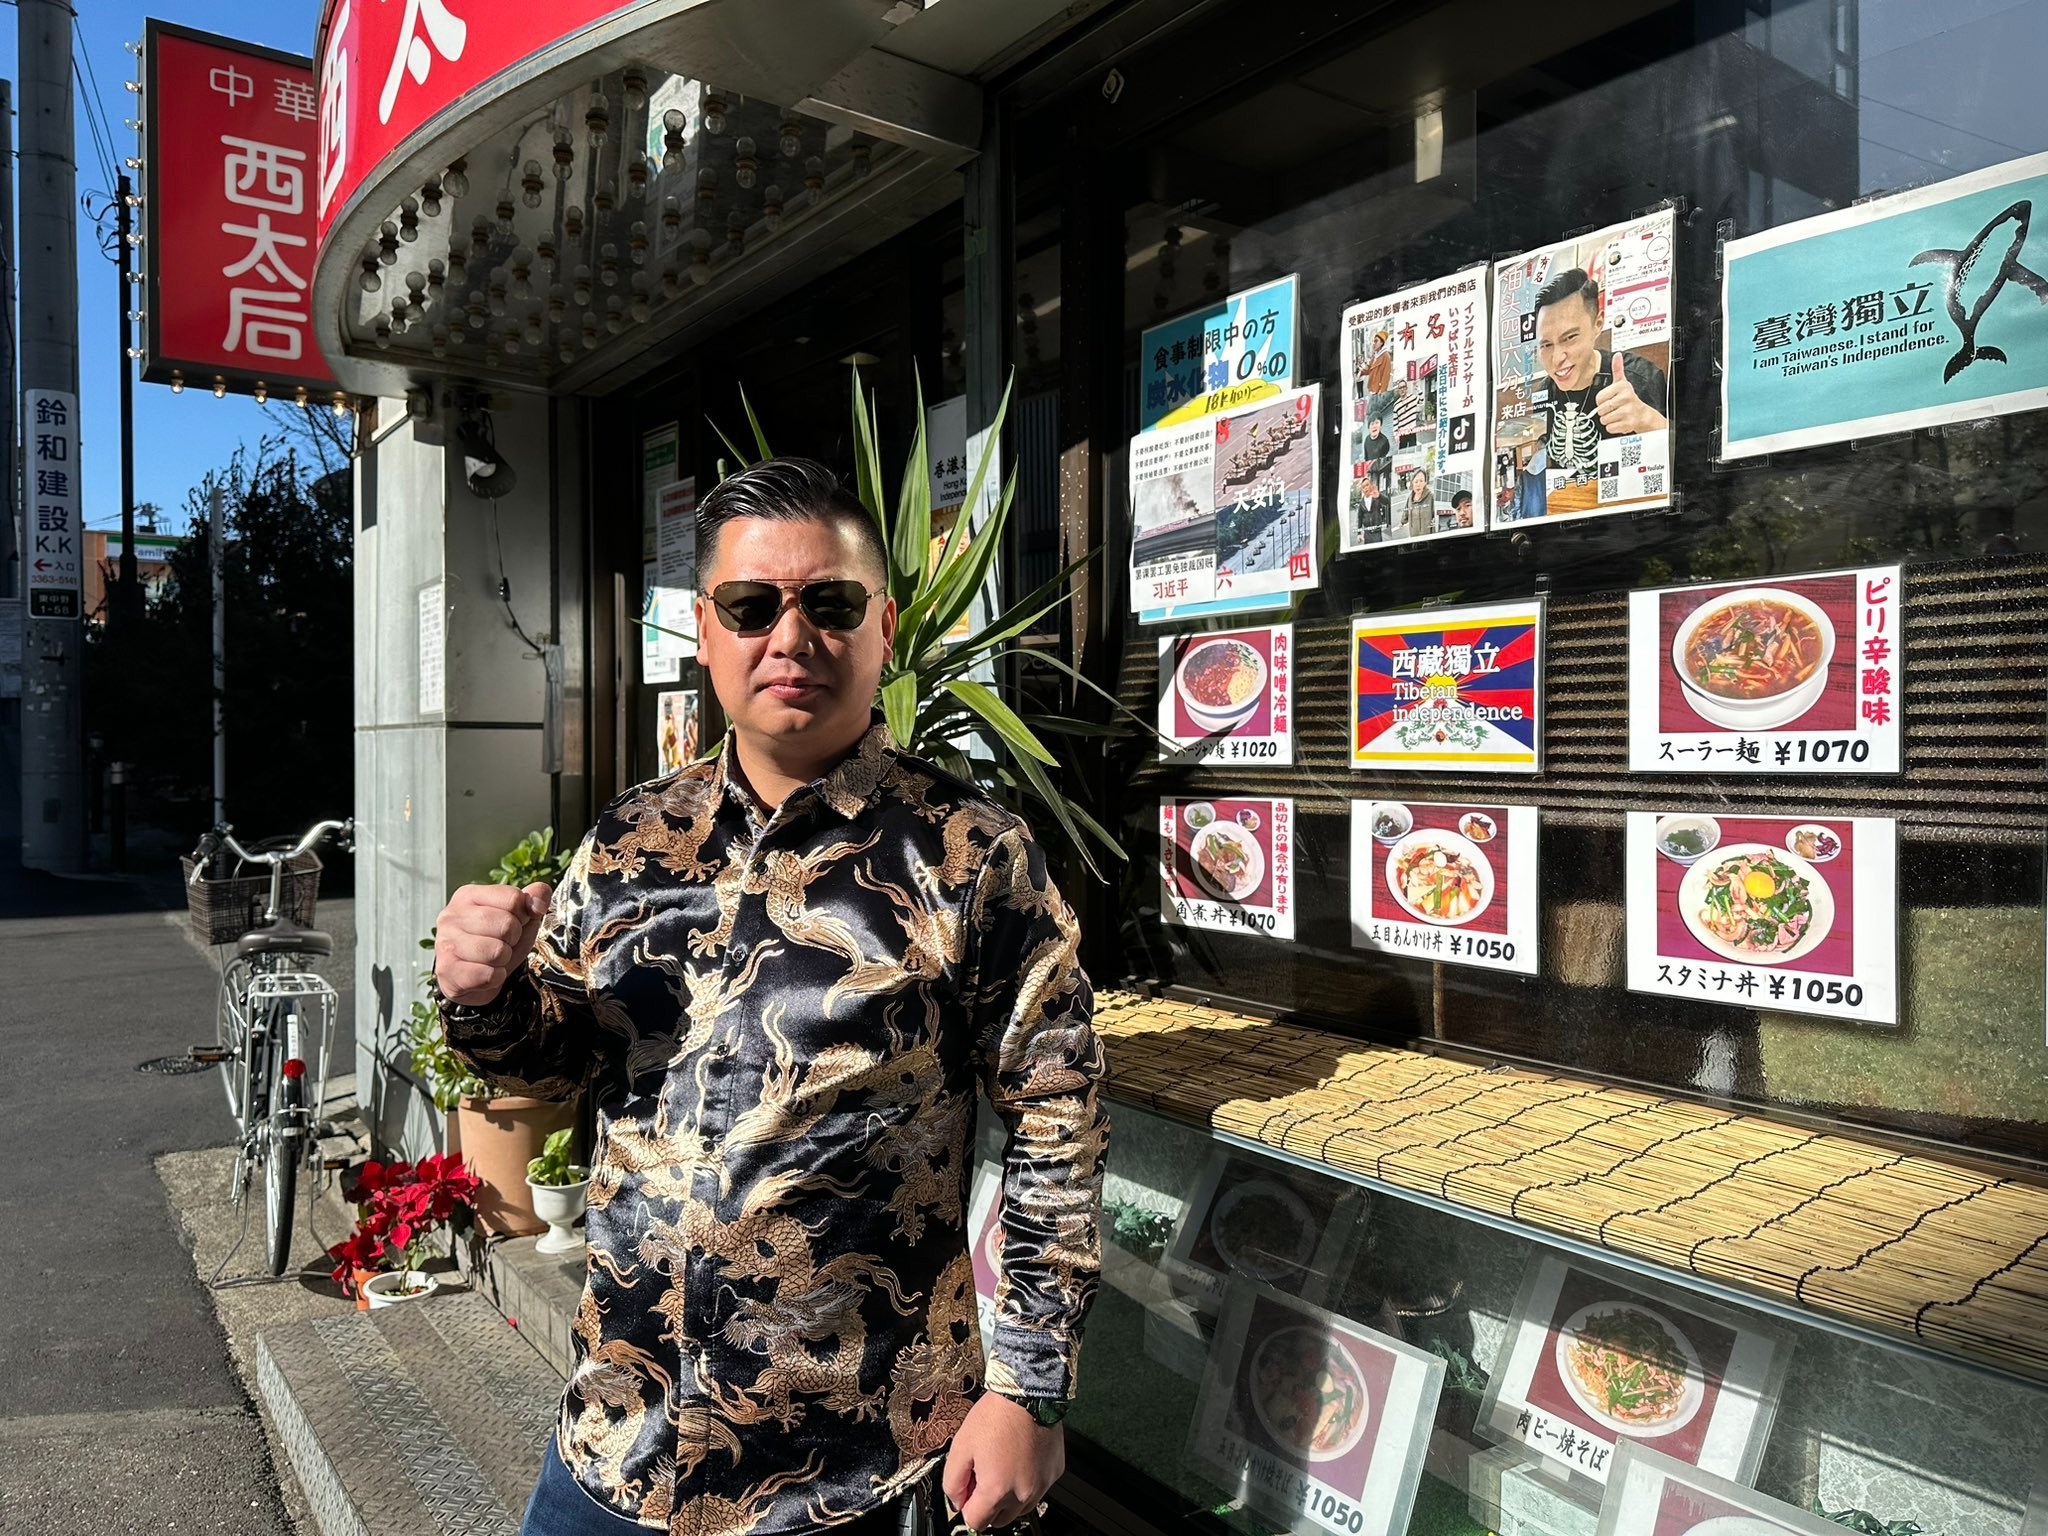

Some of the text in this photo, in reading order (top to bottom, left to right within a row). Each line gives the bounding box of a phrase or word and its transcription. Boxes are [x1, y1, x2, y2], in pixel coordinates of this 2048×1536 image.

[210, 65, 316, 122] 中華
[221, 134, 307, 361] 西太后
[1534, 256, 1550, 284] 有名
[1348, 279, 1476, 327] 受歡迎的影響者來到我們的商店
[1752, 282, 1934, 353] 臺灣獨立
[1153, 308, 1280, 372] 食事制限中の方
[1397, 313, 1445, 351] 有名
[1753, 320, 1935, 370] I am Taiwanese. I stand for
[1463, 302, 1475, 408] インフルエンサーが
[1782, 334, 1949, 377] Taiwan's Independence.
[1294, 394, 1312, 422] 9
[1501, 402, 1526, 420] 来店
[1216, 417, 1230, 445] 8
[36, 398, 69, 533] 鈴和建設
[1233, 478, 1286, 513] 天安门
[55, 562, 75, 572] 入口
[1216, 566, 1233, 590] 六
[1289, 553, 1310, 580] 四
[1152, 578, 1188, 599] 习近平
[1391, 642, 1500, 679] 西藏獨立
[1862, 576, 1891, 725] ピリ辛酸味
[1391, 682, 1458, 701] Tibetan
[1391, 703, 1523, 722] independence
[1231, 741, 1277, 758] ¥1020
[1658, 736, 1869, 765] スーラー麺 ¥1070
[1275, 803, 1288, 914] 品切れの場合が有ります
[1175, 901, 1276, 930] 角煮丼 ¥1070
[1371, 925, 1515, 962] 五目あんかけ丼 ¥1050
[1656, 963, 1863, 1007] スタミナ丼 ¥1050
[1515, 1407, 1610, 1472] 肉ピー焼そば
[1296, 1480, 1364, 1534] ¥1050
